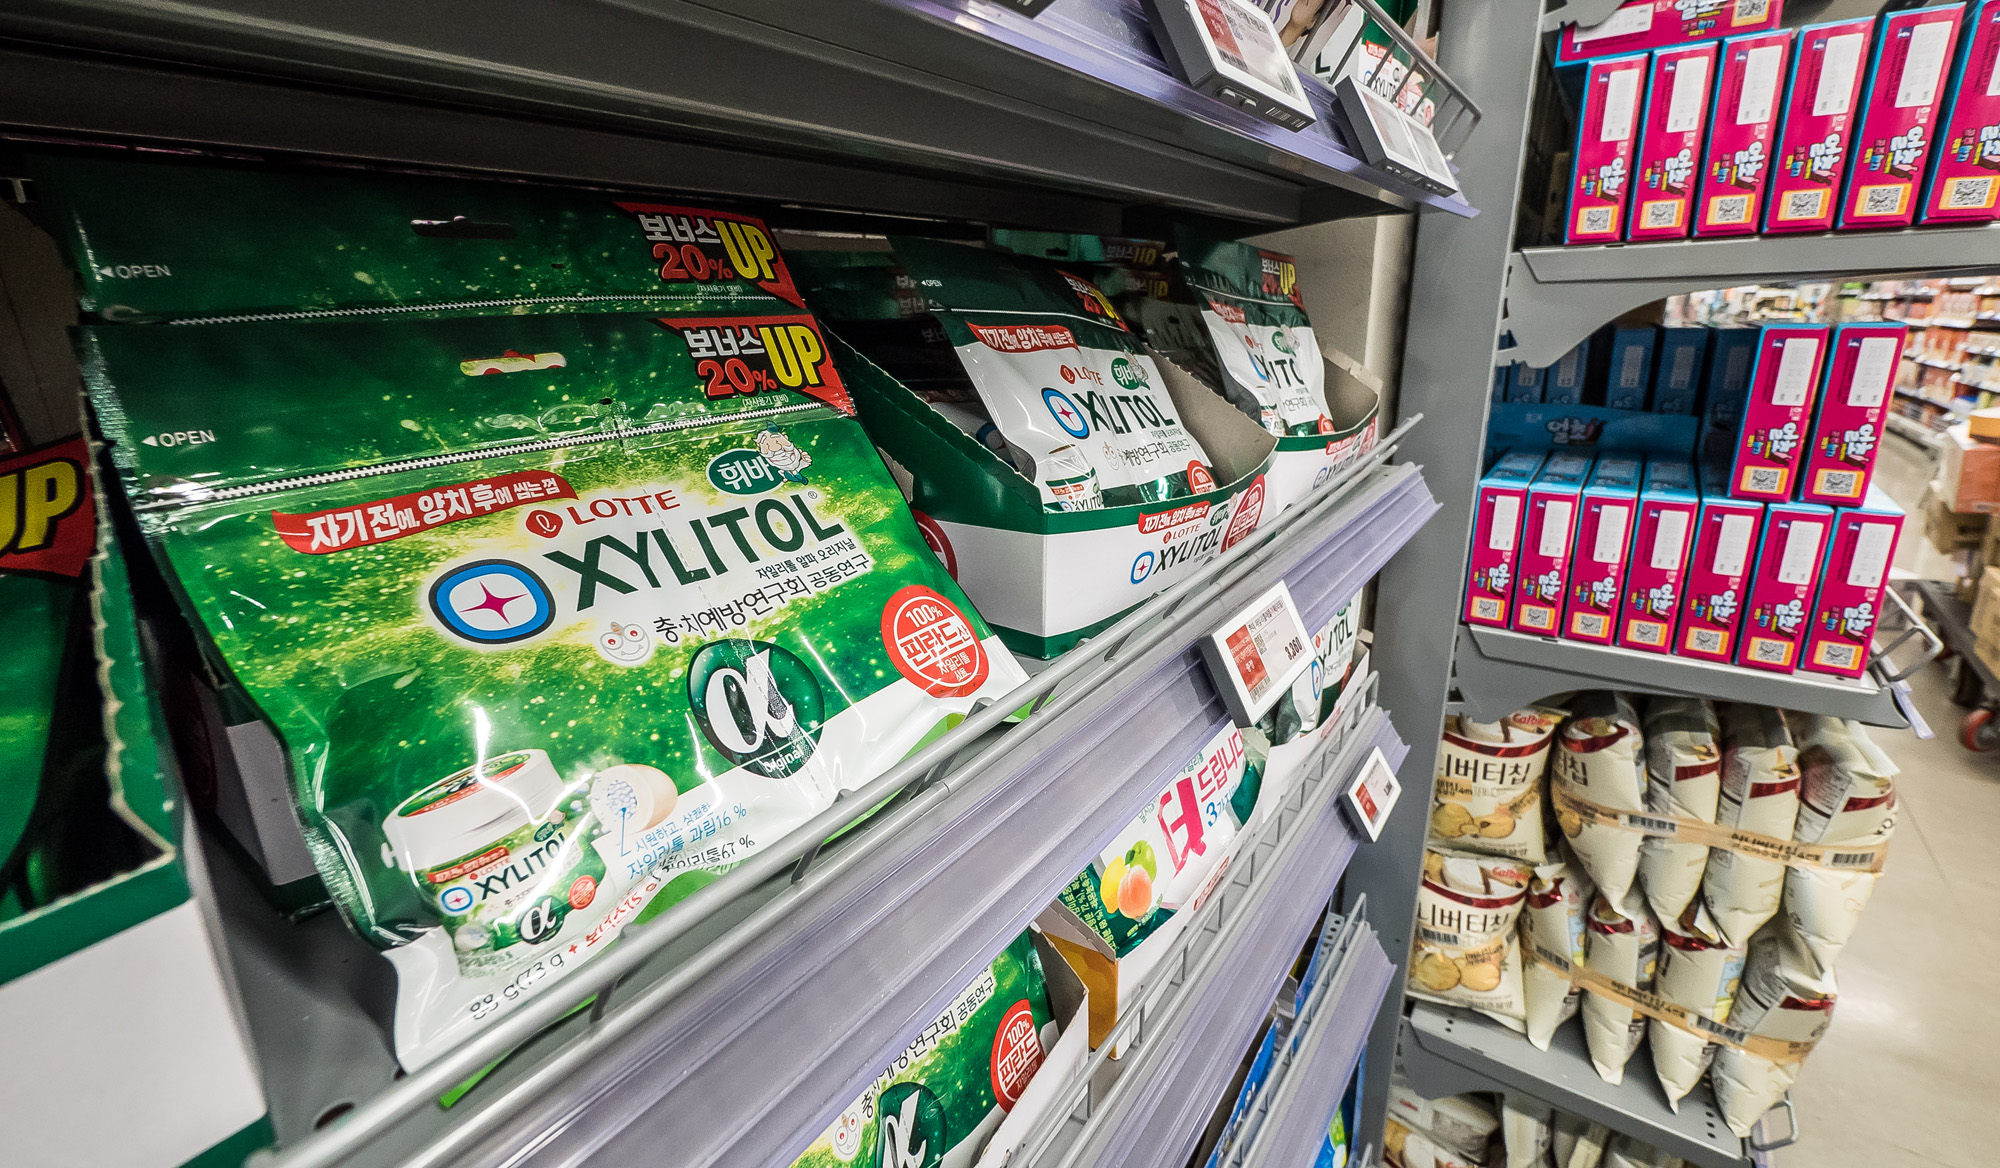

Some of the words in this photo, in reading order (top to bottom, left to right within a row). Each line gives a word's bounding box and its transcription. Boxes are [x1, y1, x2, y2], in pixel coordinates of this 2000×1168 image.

[639, 214, 721, 243] 보너스
[714, 220, 774, 279] UP
[653, 243, 733, 280] 20%
[115, 264, 171, 279] OPEN
[925, 279, 942, 287] OPEN
[1280, 262, 1296, 295] UP
[684, 329, 764, 357] 보너스
[759, 326, 821, 387] UP
[698, 358, 777, 396] 20%
[160, 430, 215, 447] OPEN
[717, 455, 774, 489] 휘바
[306, 510, 368, 551] 자기
[417, 488, 472, 525] 양치
[470, 483, 513, 511] 후에
[541, 477, 560, 495] 껌
[566, 489, 680, 526] LOTTE
[1172, 523, 1201, 540] LOTTE
[542, 494, 844, 612] XYLITOL
[755, 560, 797, 581] 자일리톨
[796, 552, 817, 569] 알파
[817, 537, 857, 561] 오리지날
[1153, 525, 1222, 575] XYLITOL
[809, 553, 870, 589] 공동연구
[905, 604, 943, 628] 100%
[900, 622, 971, 667] 핀란드산
[936, 651, 971, 675] 자일리톨
[733, 803, 747, 819] %
[635, 822, 683, 853] 시원하고,
[1006, 1019, 1031, 1048] 100%
[1000, 1032, 1038, 1089] 핀란드
